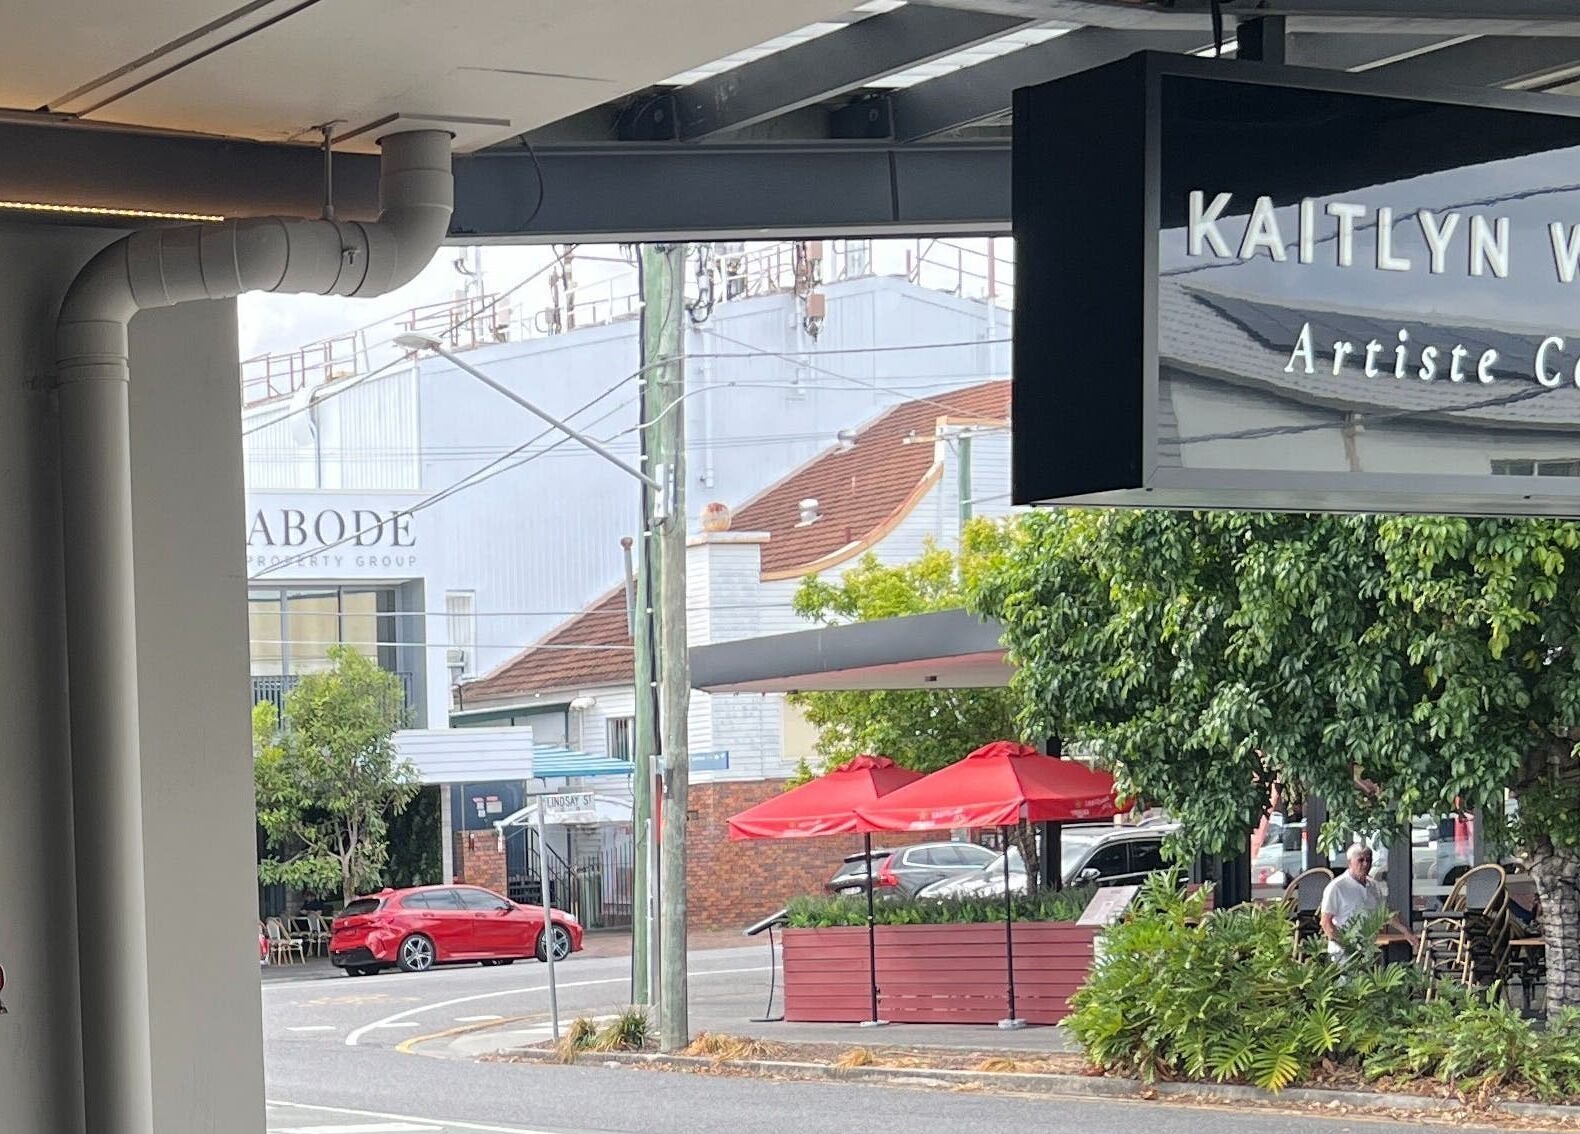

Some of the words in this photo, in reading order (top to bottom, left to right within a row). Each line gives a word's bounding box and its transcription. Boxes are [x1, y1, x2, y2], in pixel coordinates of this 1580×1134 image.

[1187, 190, 1510, 279] KAITLYN
[1283, 322, 1499, 384] Artiste
[1534, 336, 1580, 389] C
[246, 508, 417, 547] ABODE
[355, 555, 417, 568] GROUP
[547, 796, 578, 808] LINDSAY
